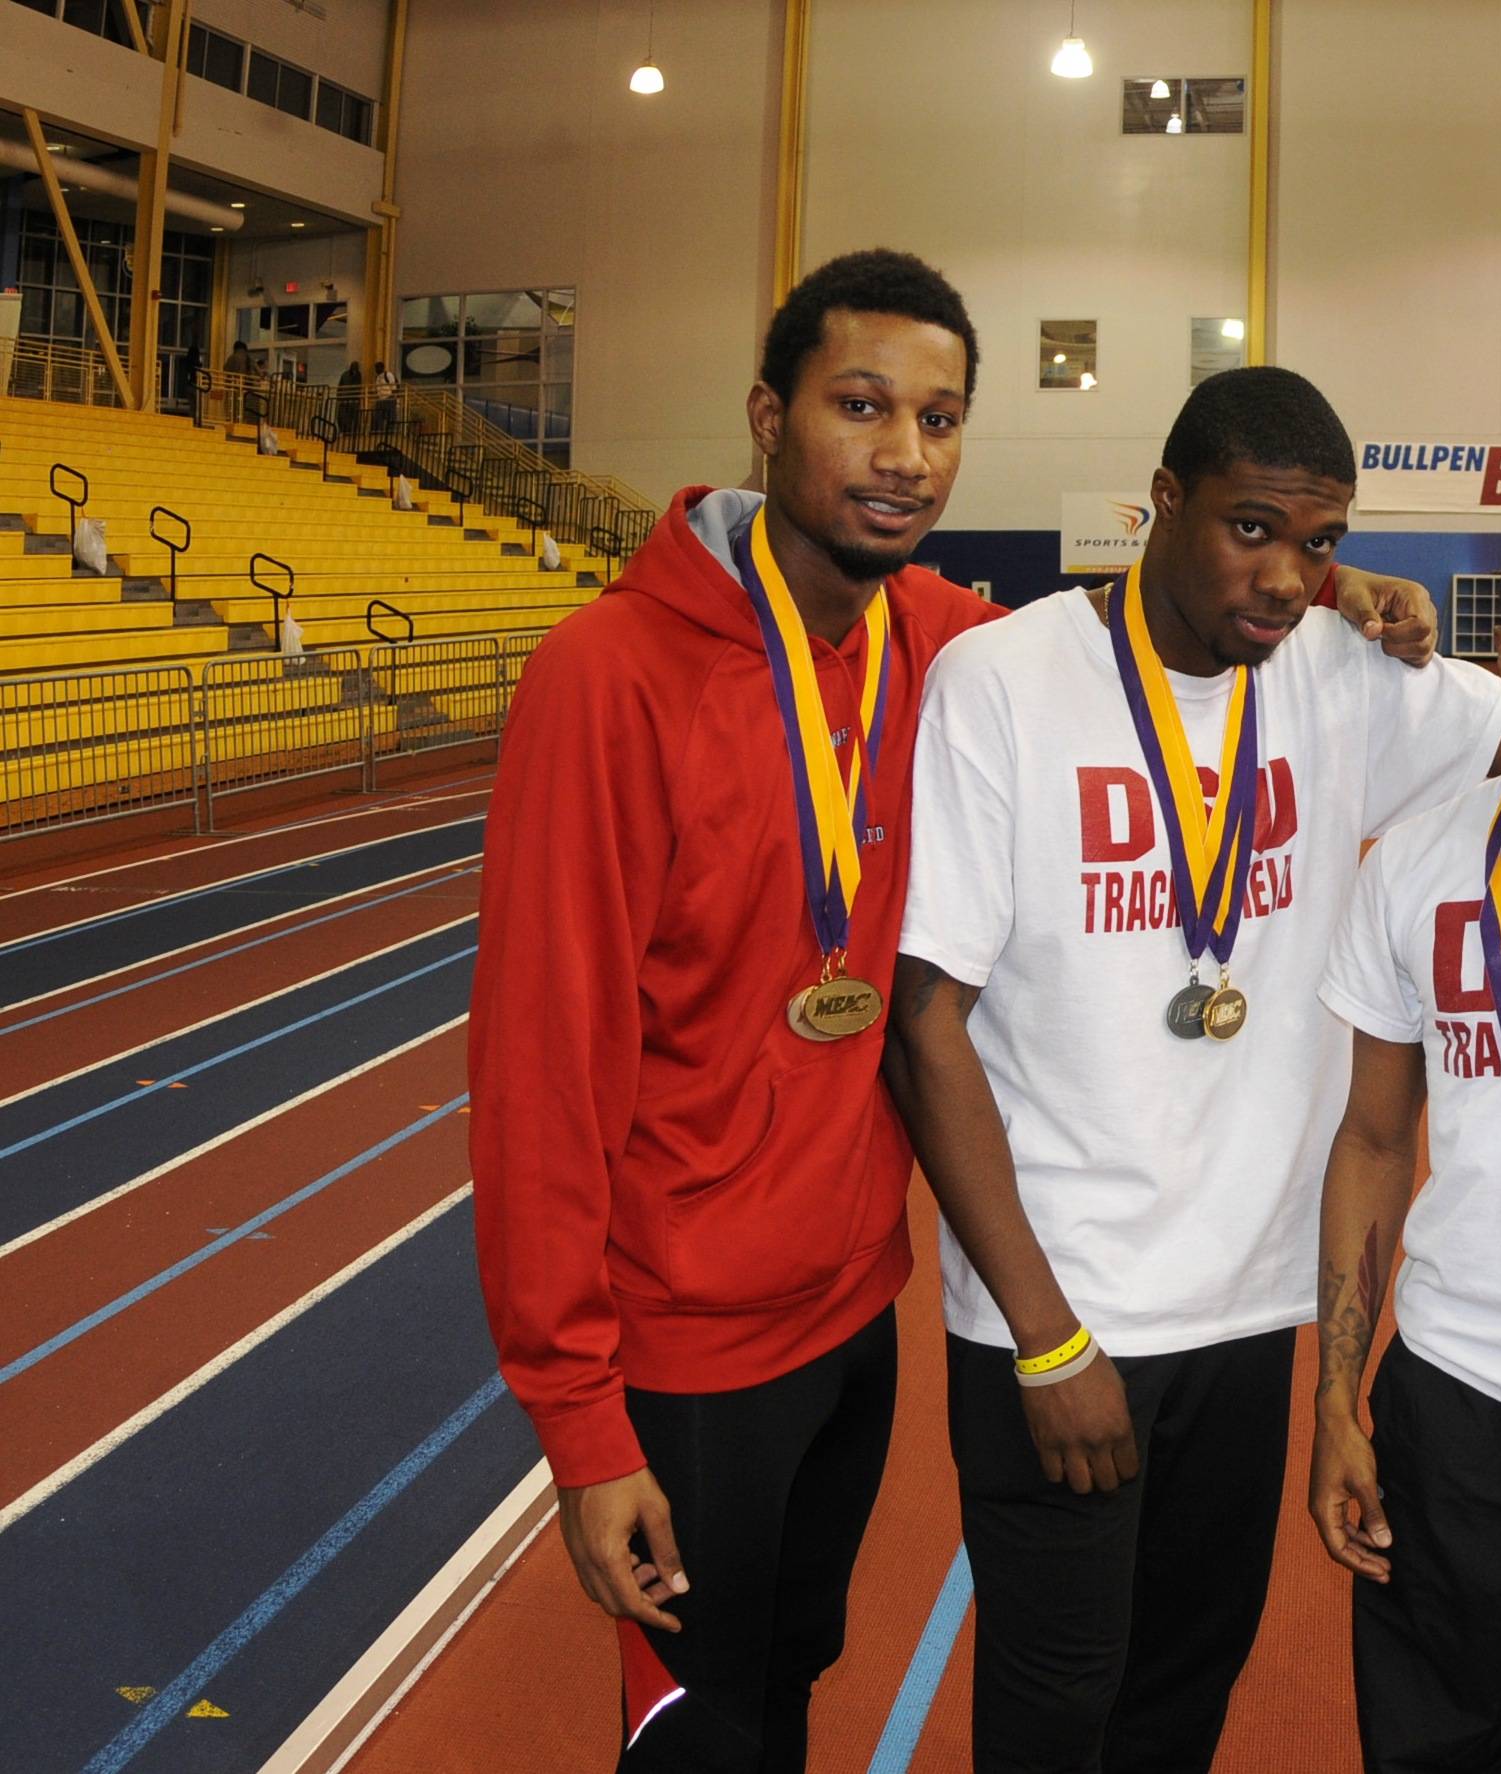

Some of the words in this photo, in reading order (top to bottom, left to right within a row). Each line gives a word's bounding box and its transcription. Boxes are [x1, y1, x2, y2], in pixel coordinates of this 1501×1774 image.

[1362, 443, 1485, 471] BULLPEN
[1074, 538, 1128, 548] SPORTS
[1076, 756, 1298, 864] DU
